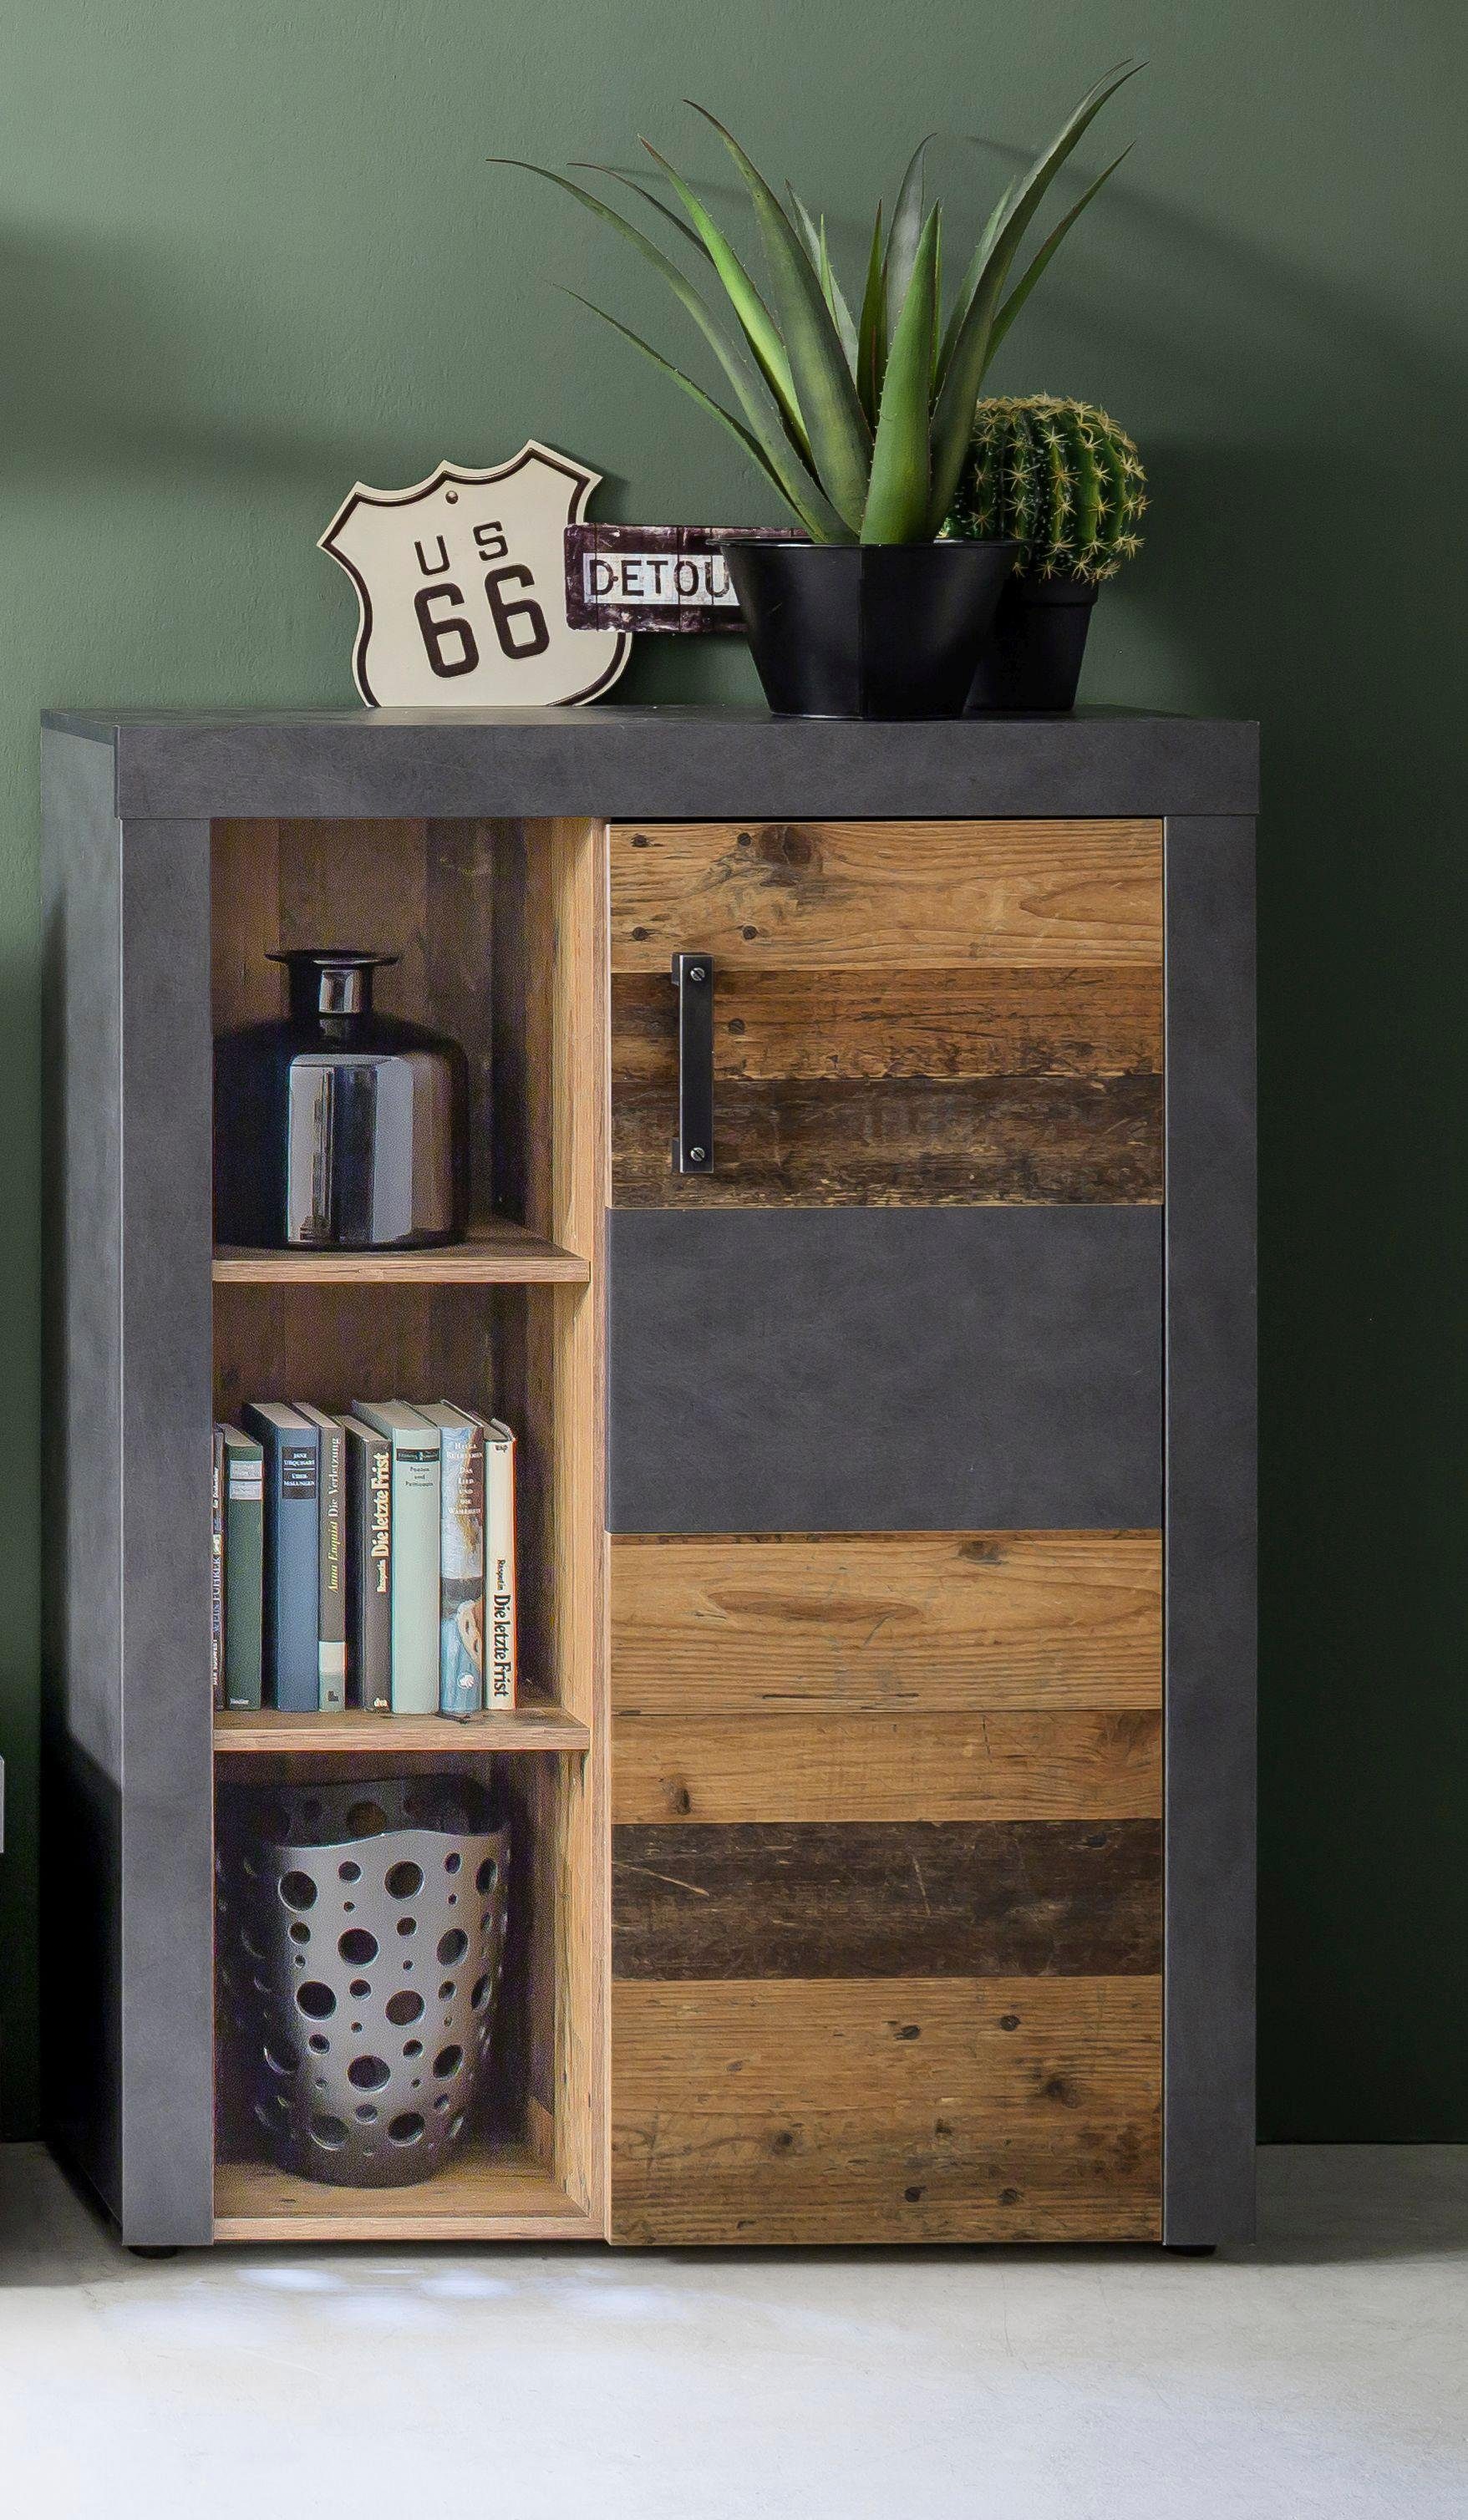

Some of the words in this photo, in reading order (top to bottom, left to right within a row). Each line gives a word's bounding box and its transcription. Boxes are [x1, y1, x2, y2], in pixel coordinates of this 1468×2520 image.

[414, 521, 508, 576] US
[589, 559, 729, 598] DETOU
[414, 563, 550, 678] 66
[371, 1452, 389, 1490] Frist
[371, 1490, 389, 1531] letzte
[371, 1532, 389, 1557] Die
[494, 1594, 511, 1618] Die
[494, 1620, 511, 1660] letzte
[494, 1661, 511, 1697] Frist
